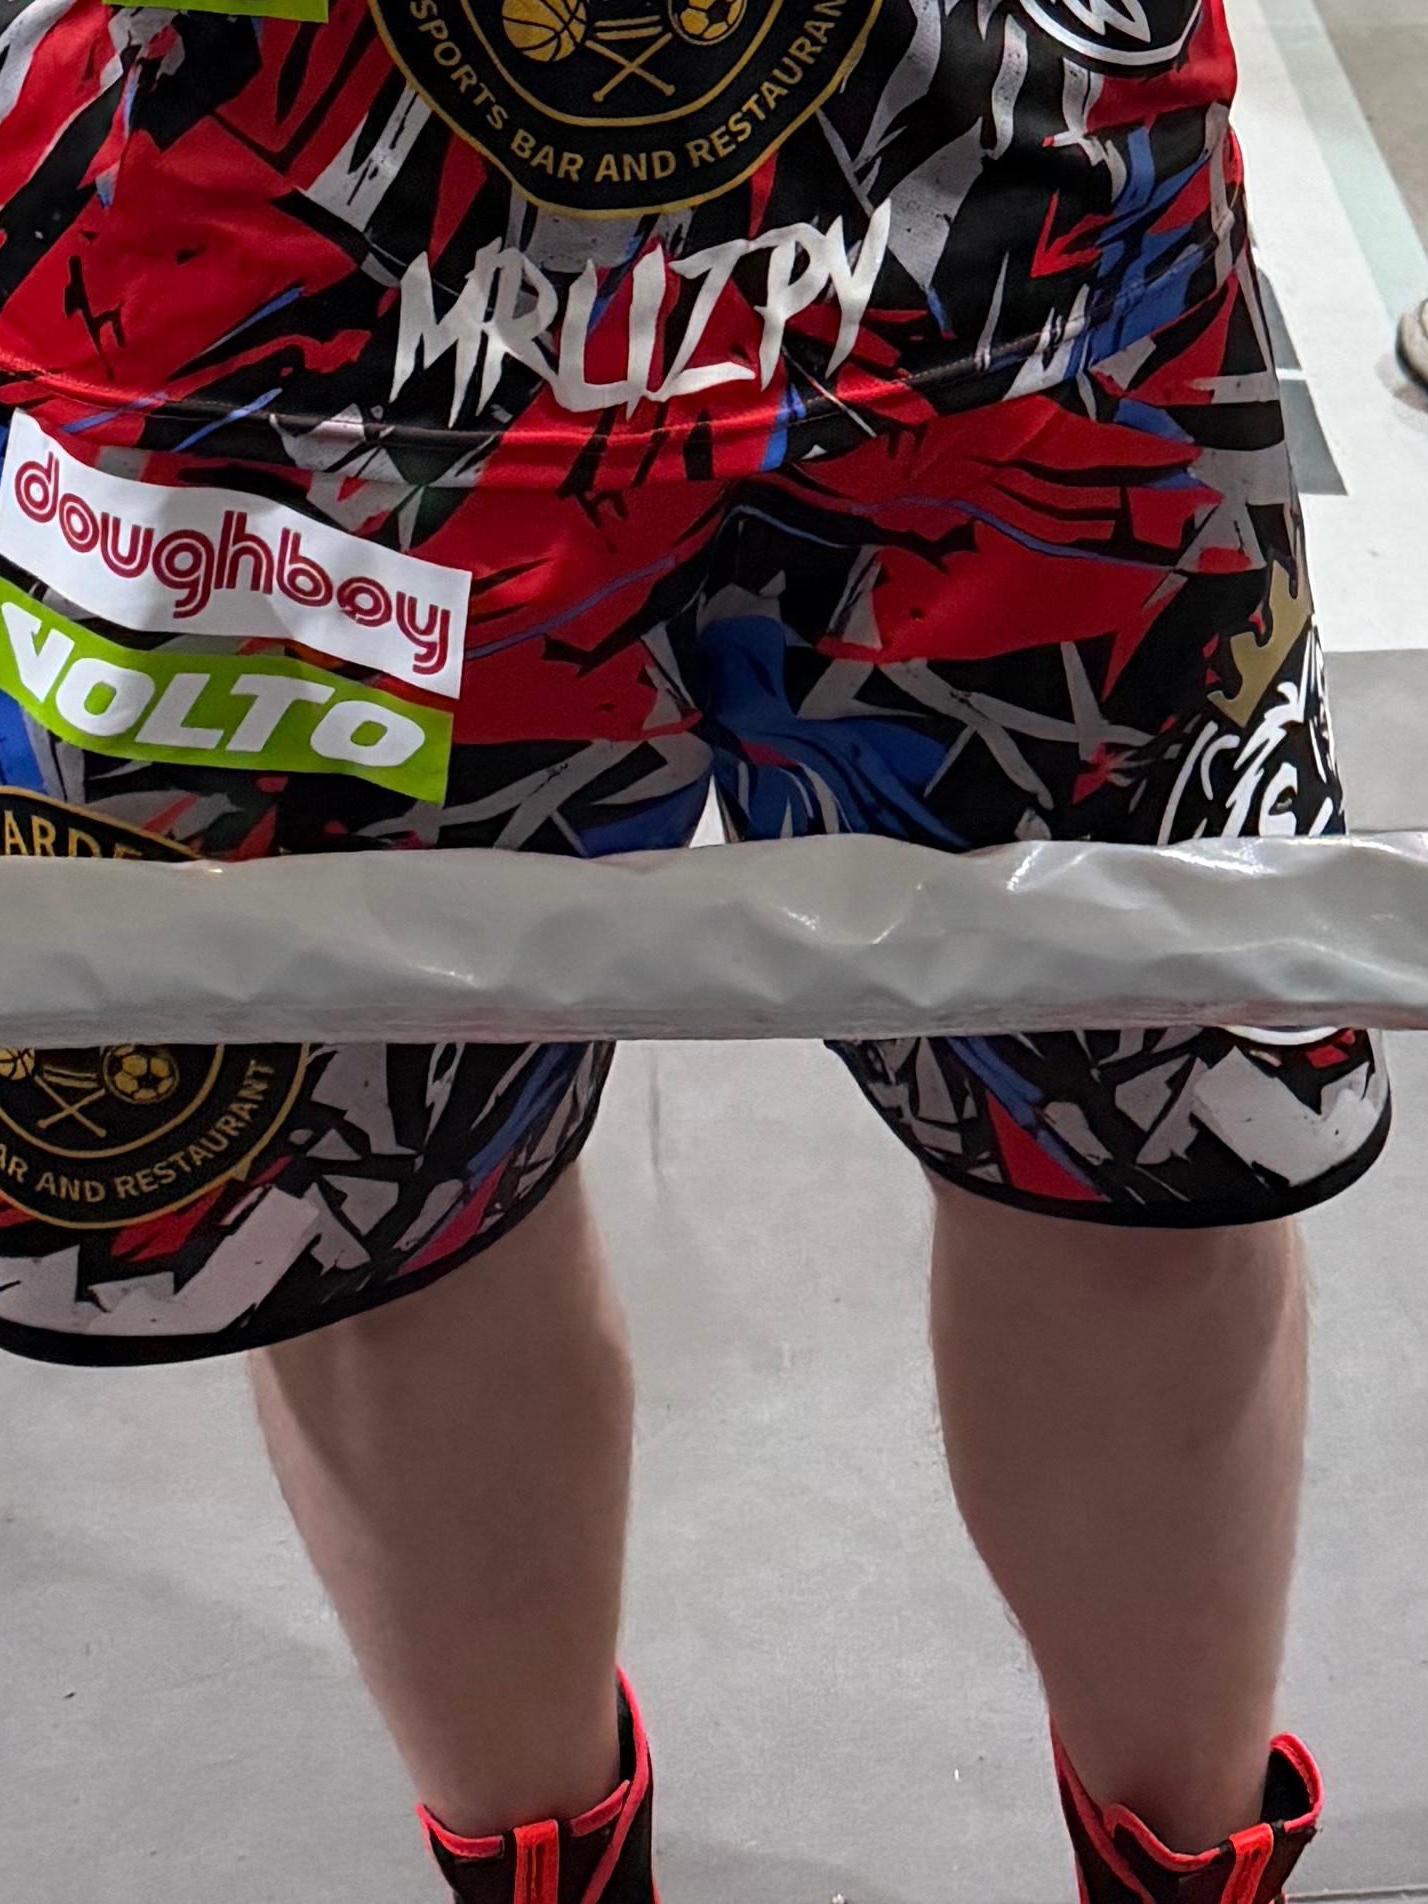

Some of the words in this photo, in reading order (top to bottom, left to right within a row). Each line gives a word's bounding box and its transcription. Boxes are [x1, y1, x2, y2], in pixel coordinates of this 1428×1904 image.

[509, 127, 585, 183] BAR
[594, 149, 675, 184] AND
[12, 450, 452, 675] doughboy
[0, 600, 430, 770] VOLTO
[34, 1170, 107, 1203] AND
[114, 1057, 276, 1200] RESTAURANT
